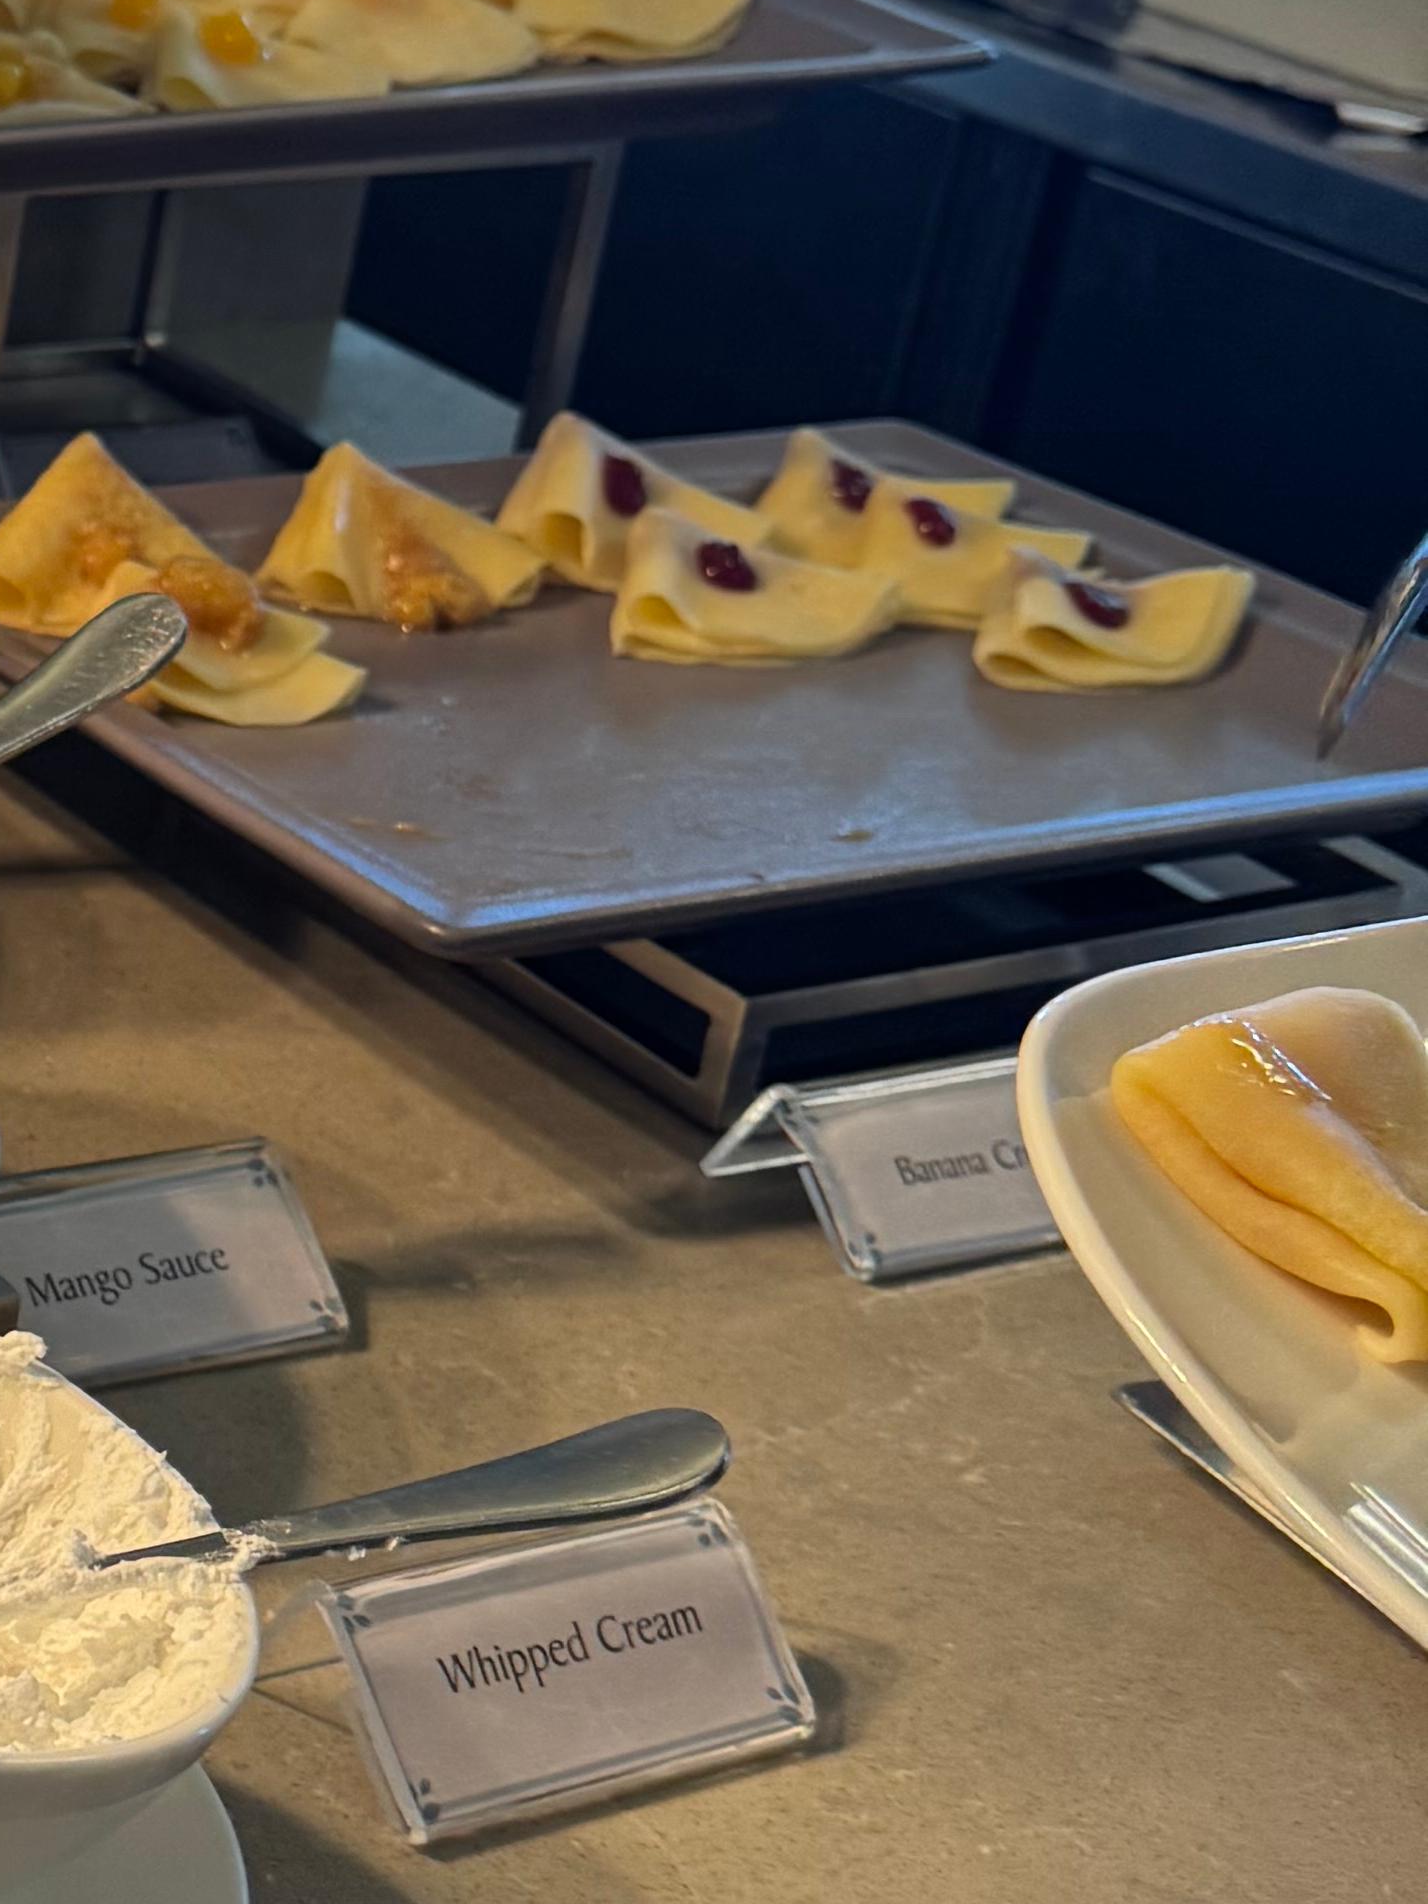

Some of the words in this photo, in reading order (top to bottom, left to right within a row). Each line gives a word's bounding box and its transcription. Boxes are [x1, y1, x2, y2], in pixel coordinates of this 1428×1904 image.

[894, 1152, 988, 1186] Banana
[24, 1267, 133, 1308] Mango
[138, 1246, 230, 1286] Sauce
[436, 1620, 590, 1694] Whipped
[596, 1604, 704, 1654] Cream
